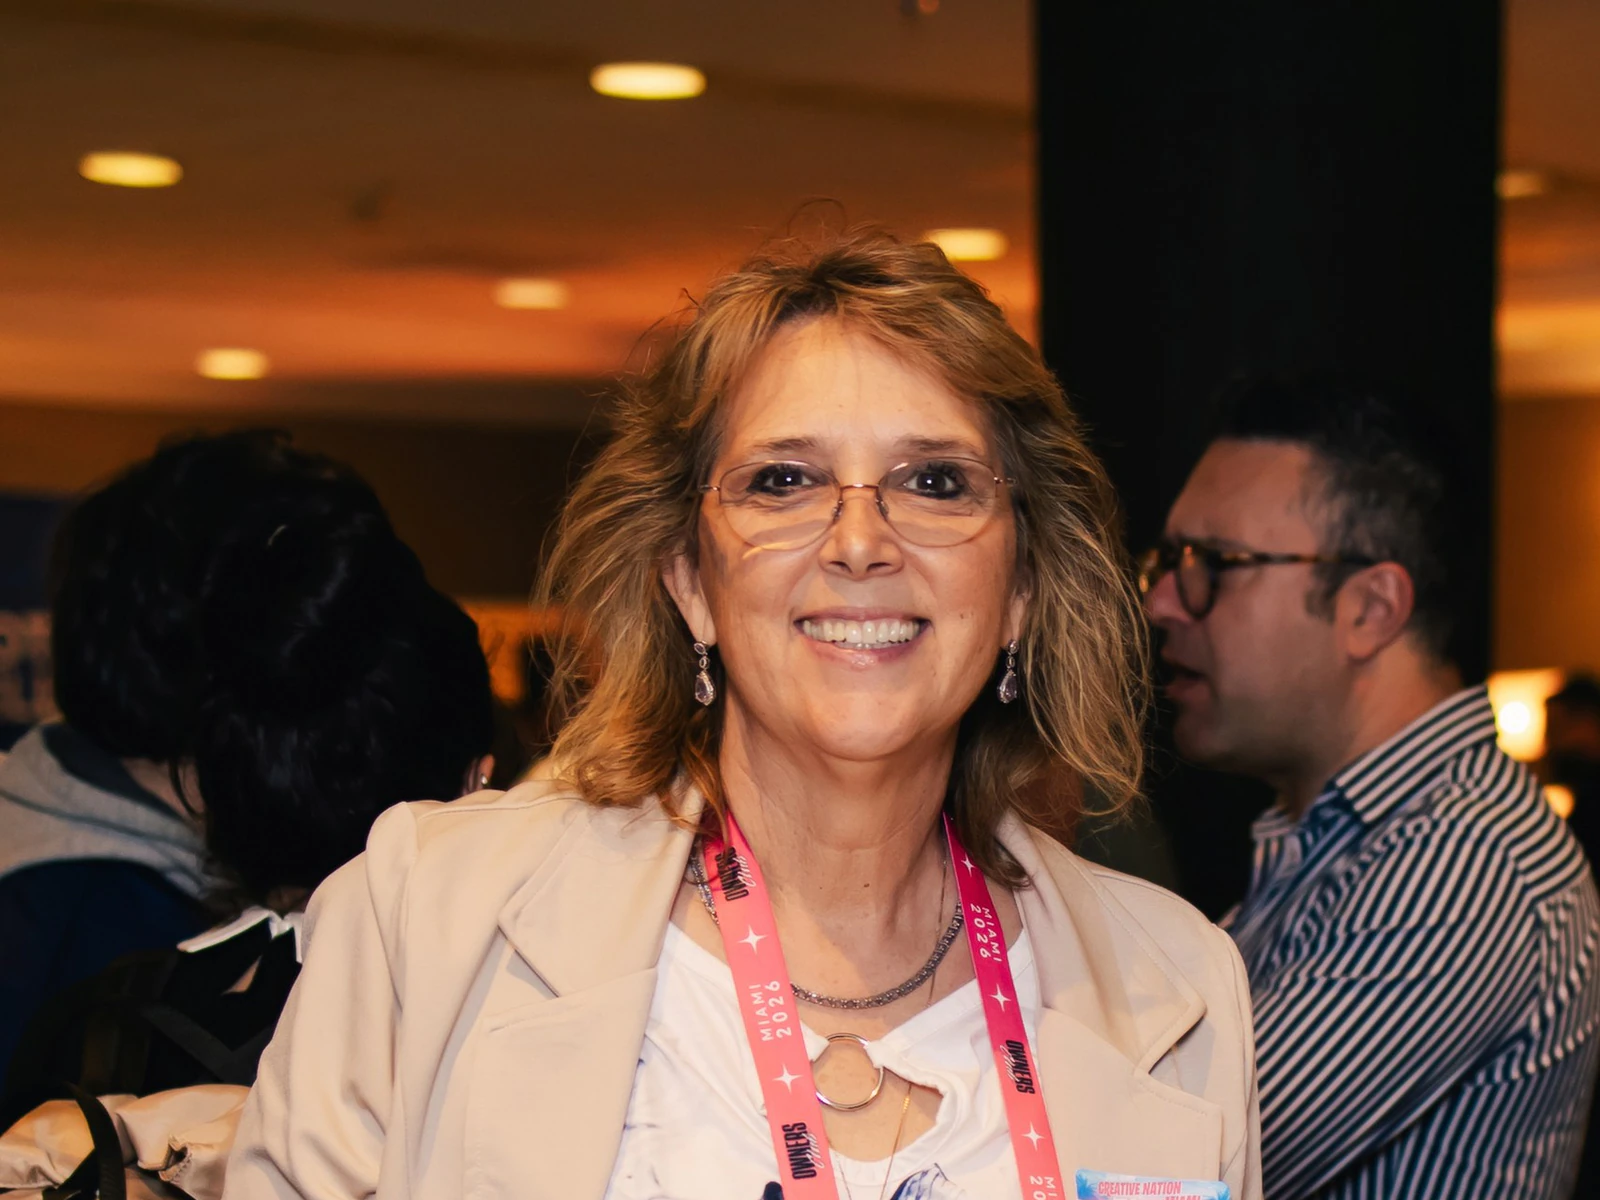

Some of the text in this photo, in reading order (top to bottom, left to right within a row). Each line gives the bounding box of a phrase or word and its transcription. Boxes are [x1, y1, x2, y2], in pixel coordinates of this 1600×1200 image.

[971, 904, 991, 959] 2026
[981, 907, 1003, 963] MIAMI
[749, 984, 774, 1042] MIAMI
[765, 980, 792, 1040] 2026
[1005, 1040, 1035, 1094] OWNERS
[782, 1122, 817, 1180] OWNERS
[1098, 1181, 1182, 1197] CREATIVE NATION
